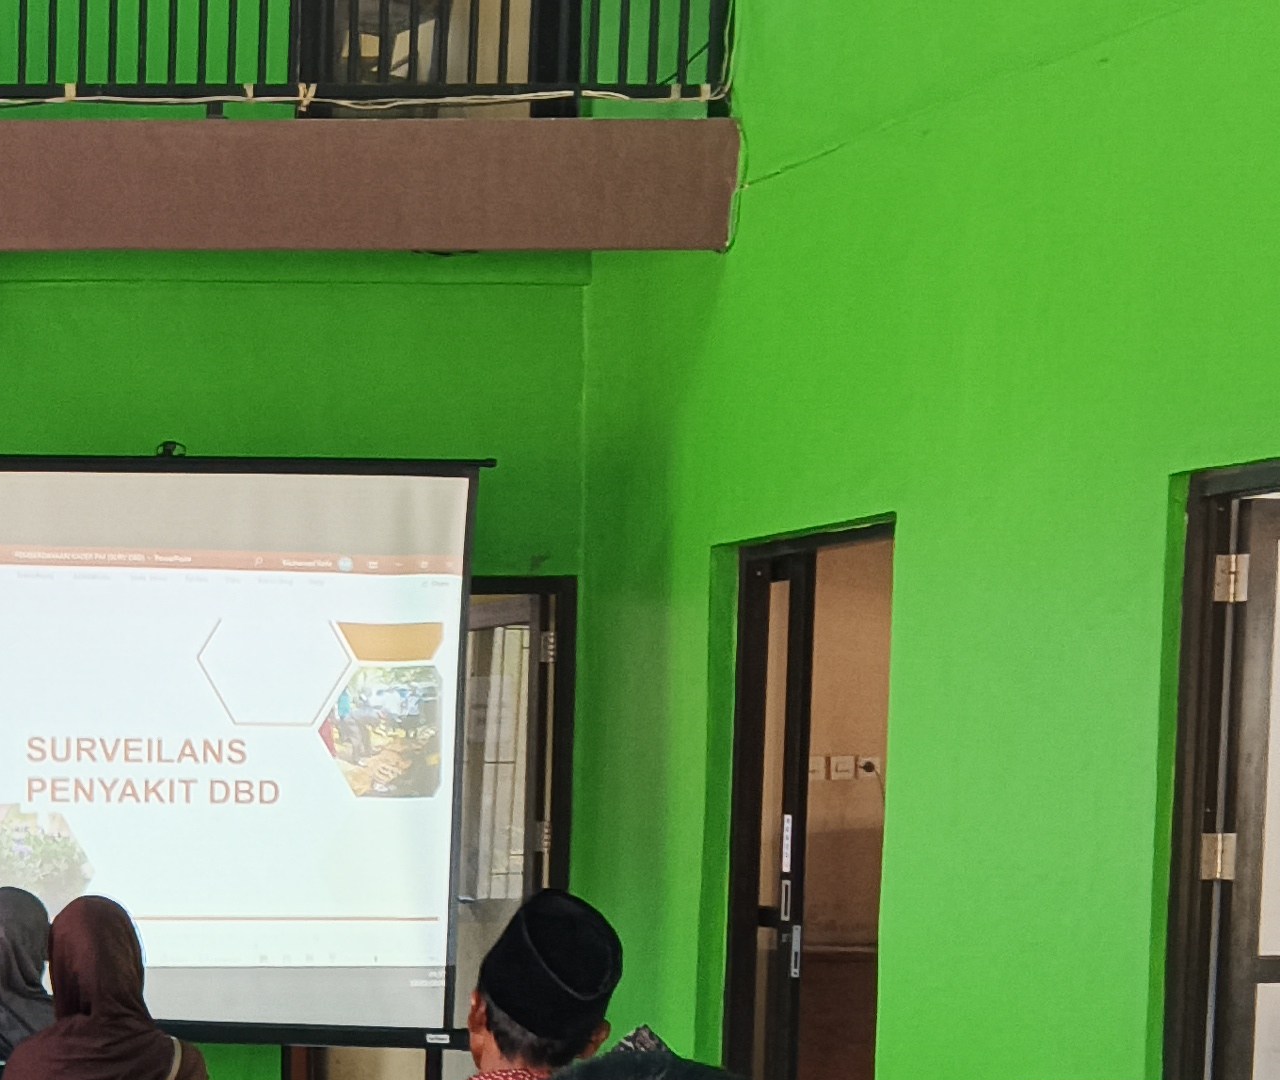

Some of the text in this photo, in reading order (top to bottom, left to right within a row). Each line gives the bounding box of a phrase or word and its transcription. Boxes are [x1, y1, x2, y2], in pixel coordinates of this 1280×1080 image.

[26, 736, 248, 764] SURVEILANS
[27, 777, 281, 805] PENYAKIT DBD
